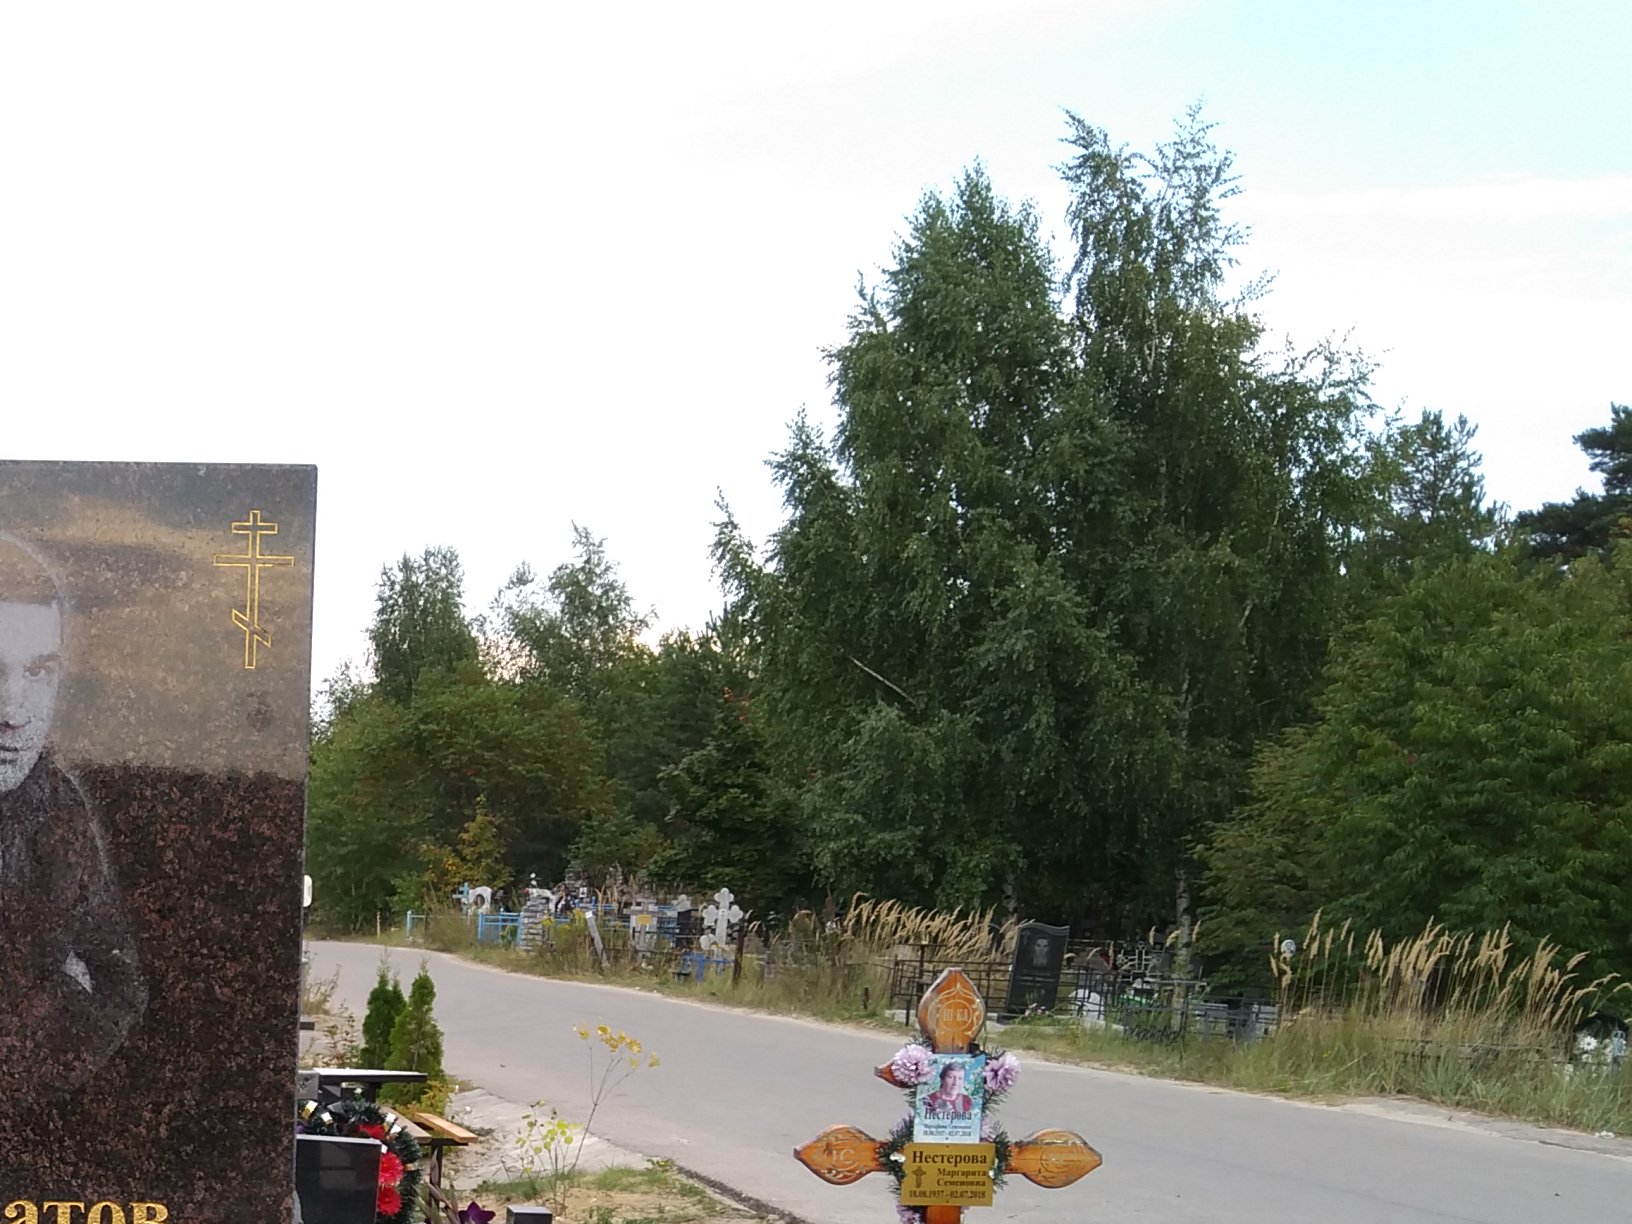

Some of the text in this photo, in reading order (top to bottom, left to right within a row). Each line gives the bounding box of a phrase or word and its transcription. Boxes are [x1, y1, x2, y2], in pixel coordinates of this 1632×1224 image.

[924, 1108, 972, 1124] Нестерова
[912, 1151, 987, 1167] Нестерова
[937, 1168, 987, 1179] Маргарита
[937, 1178, 986, 1187] Семеновна
